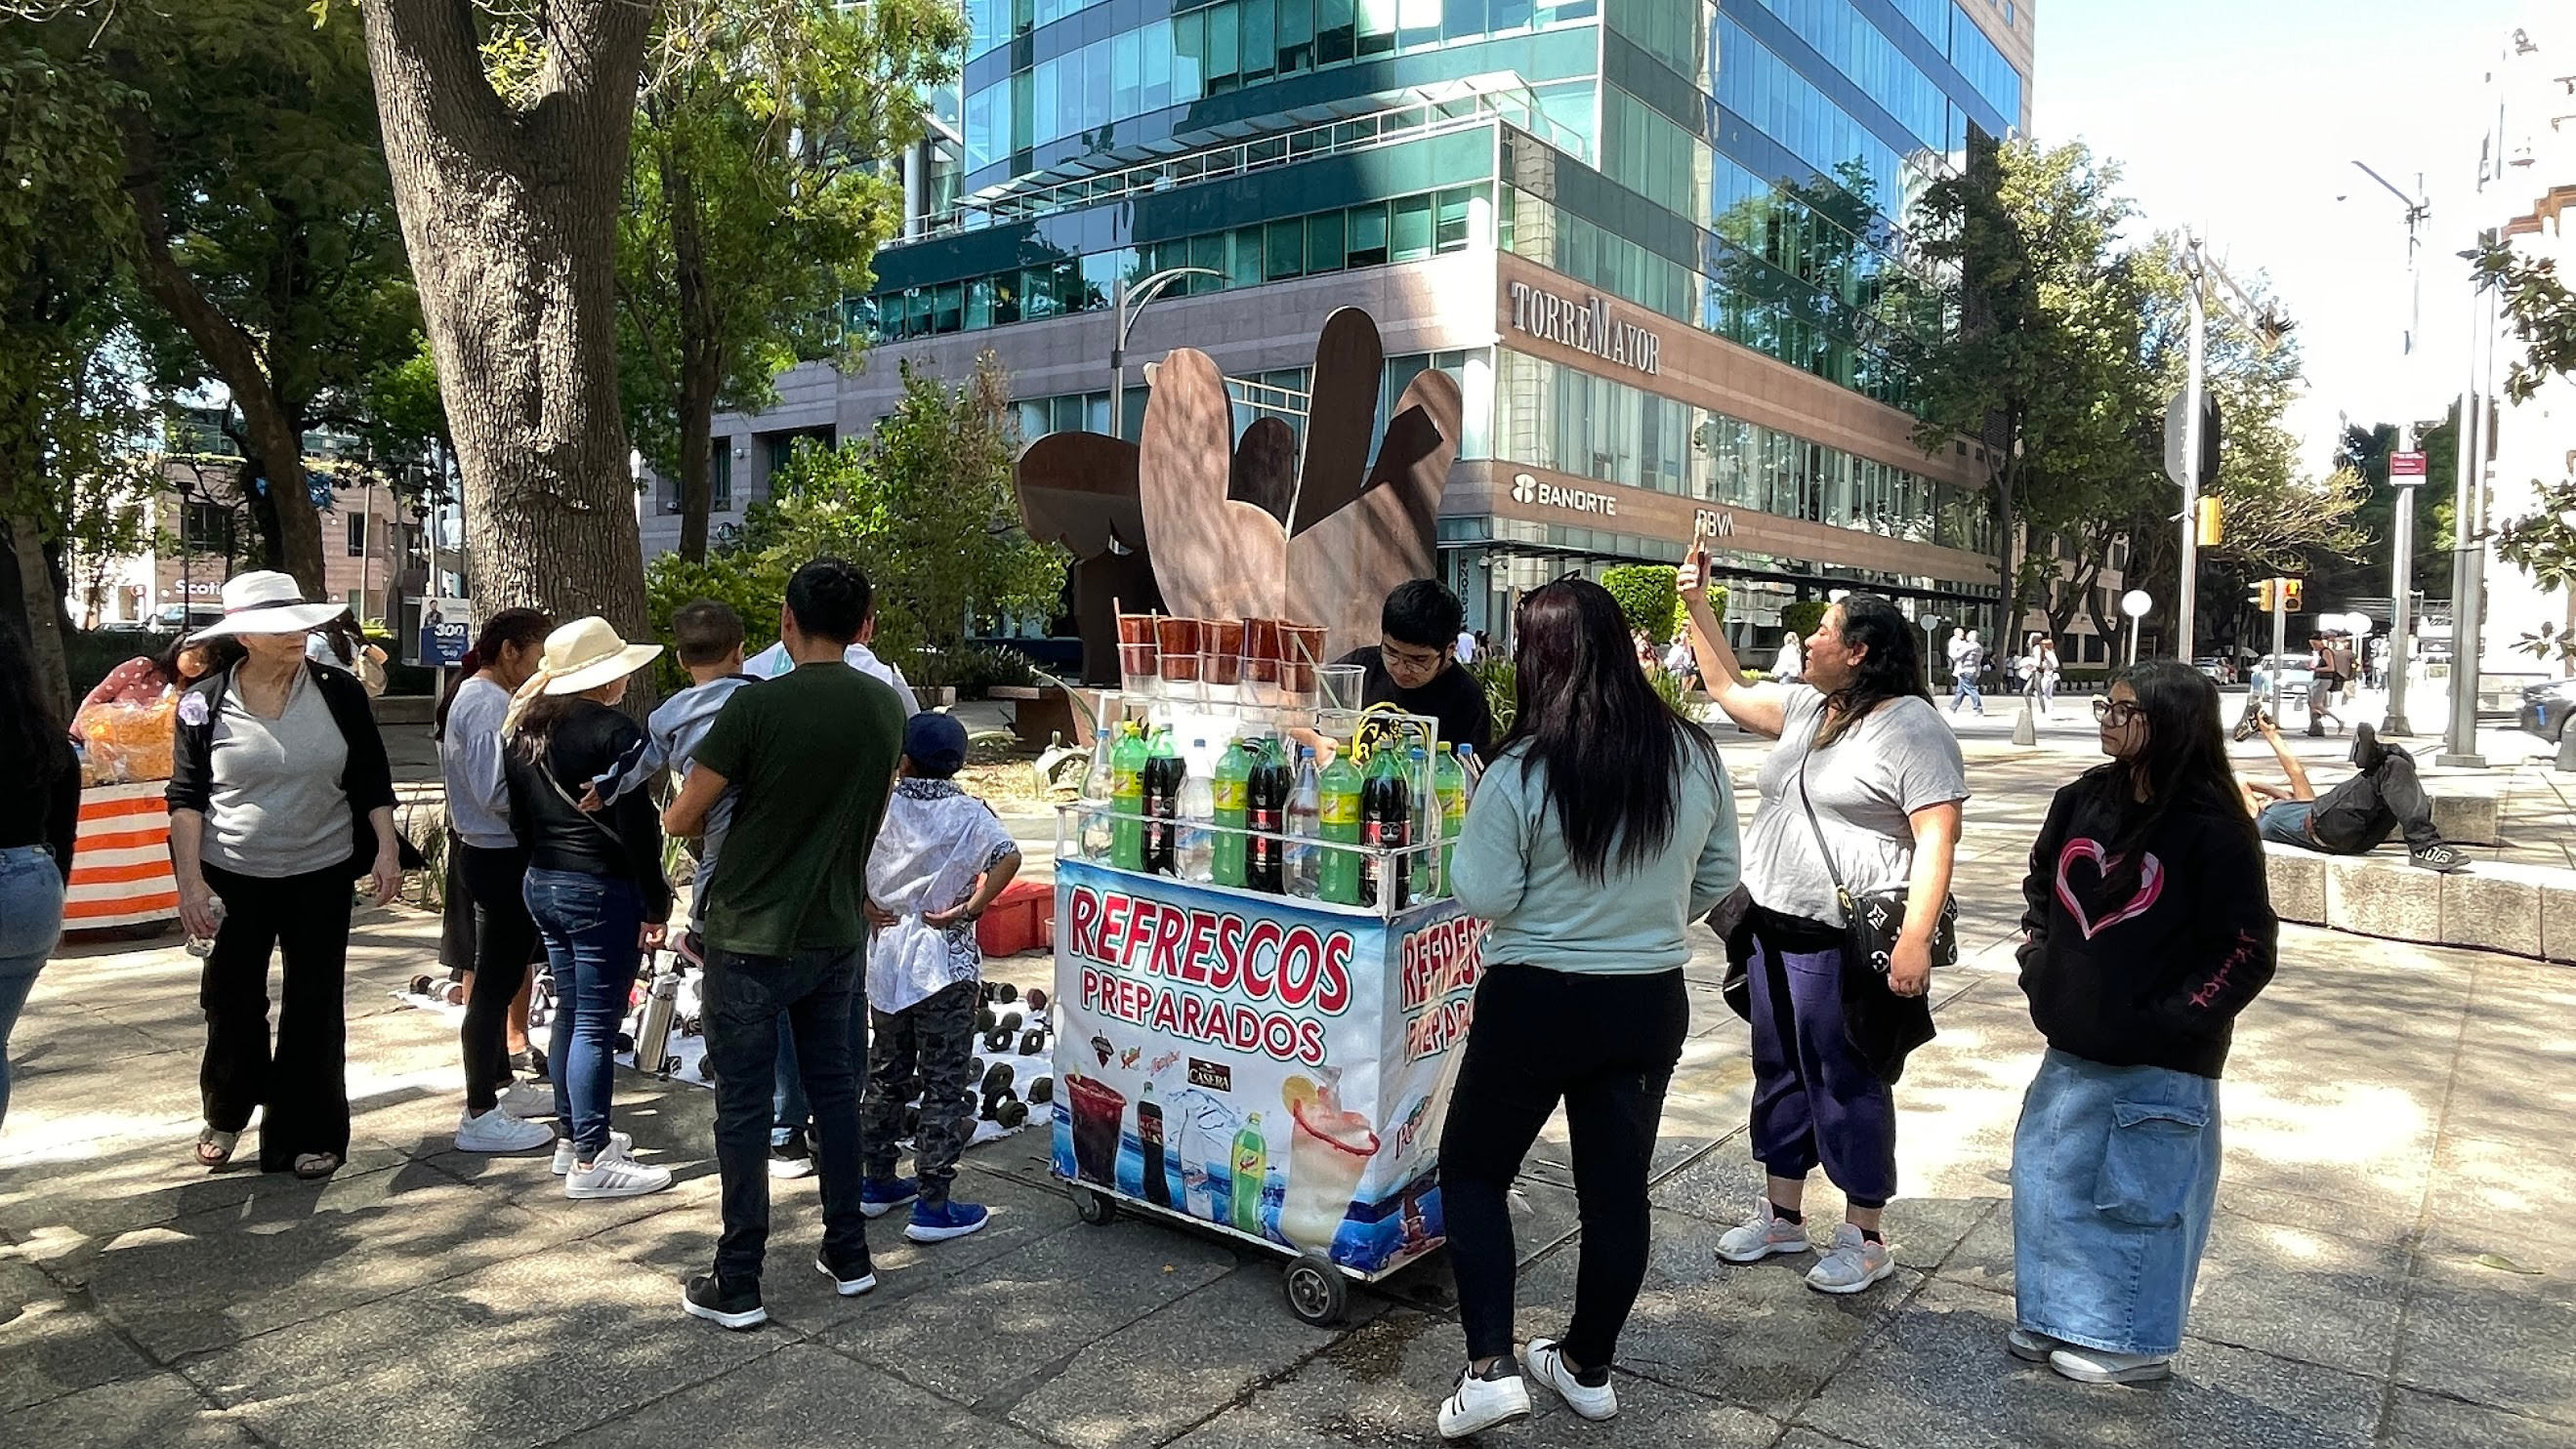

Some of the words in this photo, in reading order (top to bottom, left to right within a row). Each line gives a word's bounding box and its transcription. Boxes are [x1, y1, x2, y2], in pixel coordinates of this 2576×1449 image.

[1538, 482, 1617, 517] BANORTE
[1070, 887, 1354, 1014] REFRESCOS
[1082, 968, 1326, 1066] PREPARADOS
